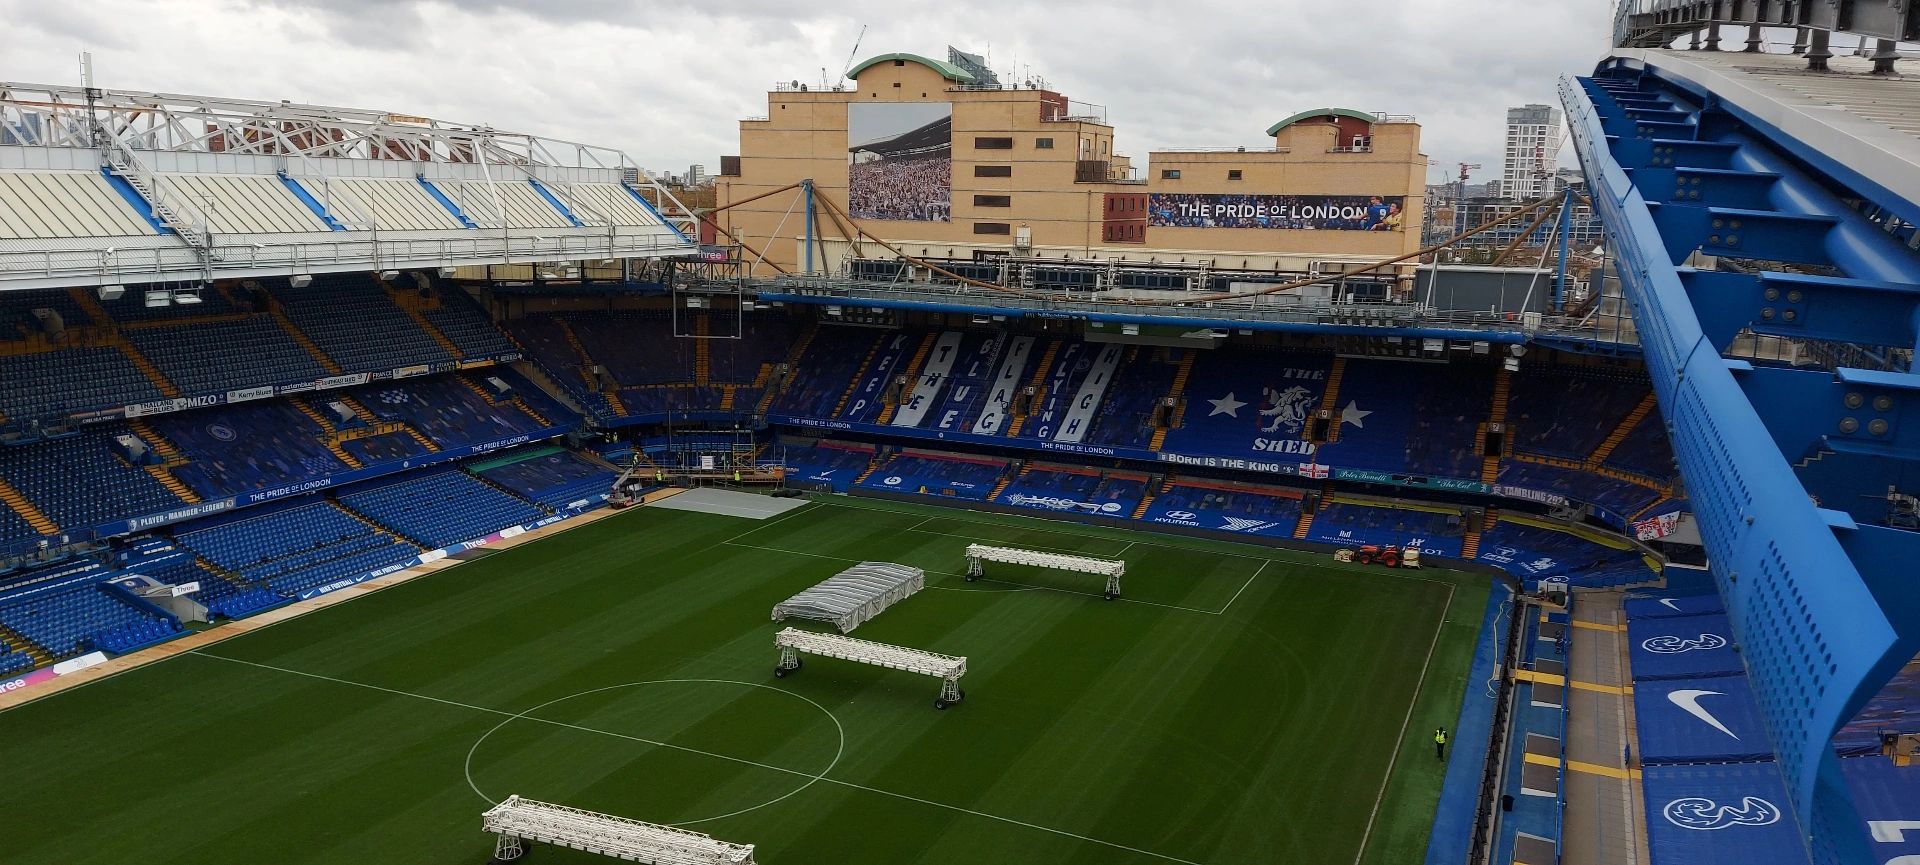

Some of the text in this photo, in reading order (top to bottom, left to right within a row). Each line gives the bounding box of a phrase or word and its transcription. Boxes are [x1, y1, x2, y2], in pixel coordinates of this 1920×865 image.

[1179, 204, 1369, 220] THE PRIDE OF LONDON
[1283, 367, 1324, 381] THE
[238, 388, 272, 400] Kerry Blues
[187, 395, 217, 408] MIZO
[789, 417, 801, 425] THE
[801, 418, 819, 427] PRIDE
[826, 420, 852, 430] LONDON
[471, 444, 483, 453] THE
[507, 435, 529, 446] LONDON
[1041, 442, 1053, 450] THE
[1055, 443, 1075, 452] PRIDE
[1084, 446, 1114, 456] LONDON
[1252, 437, 1316, 456] SHED
[1168, 453, 1279, 473] BORN IS THE KING
[249, 492, 265, 502] THE
[267, 487, 290, 499] PRIDE
[300, 478, 331, 491] LONDON
[1504, 486, 1546, 502] TAMBLING
[140, 501, 225, 527] PLAYER MANAGER LEGEND
[1154, 517, 1199, 527] HYUNDAI
[461, 538, 487, 550] Three
[176, 585, 195, 593] Three
[0, 679, 26, 693] ree
